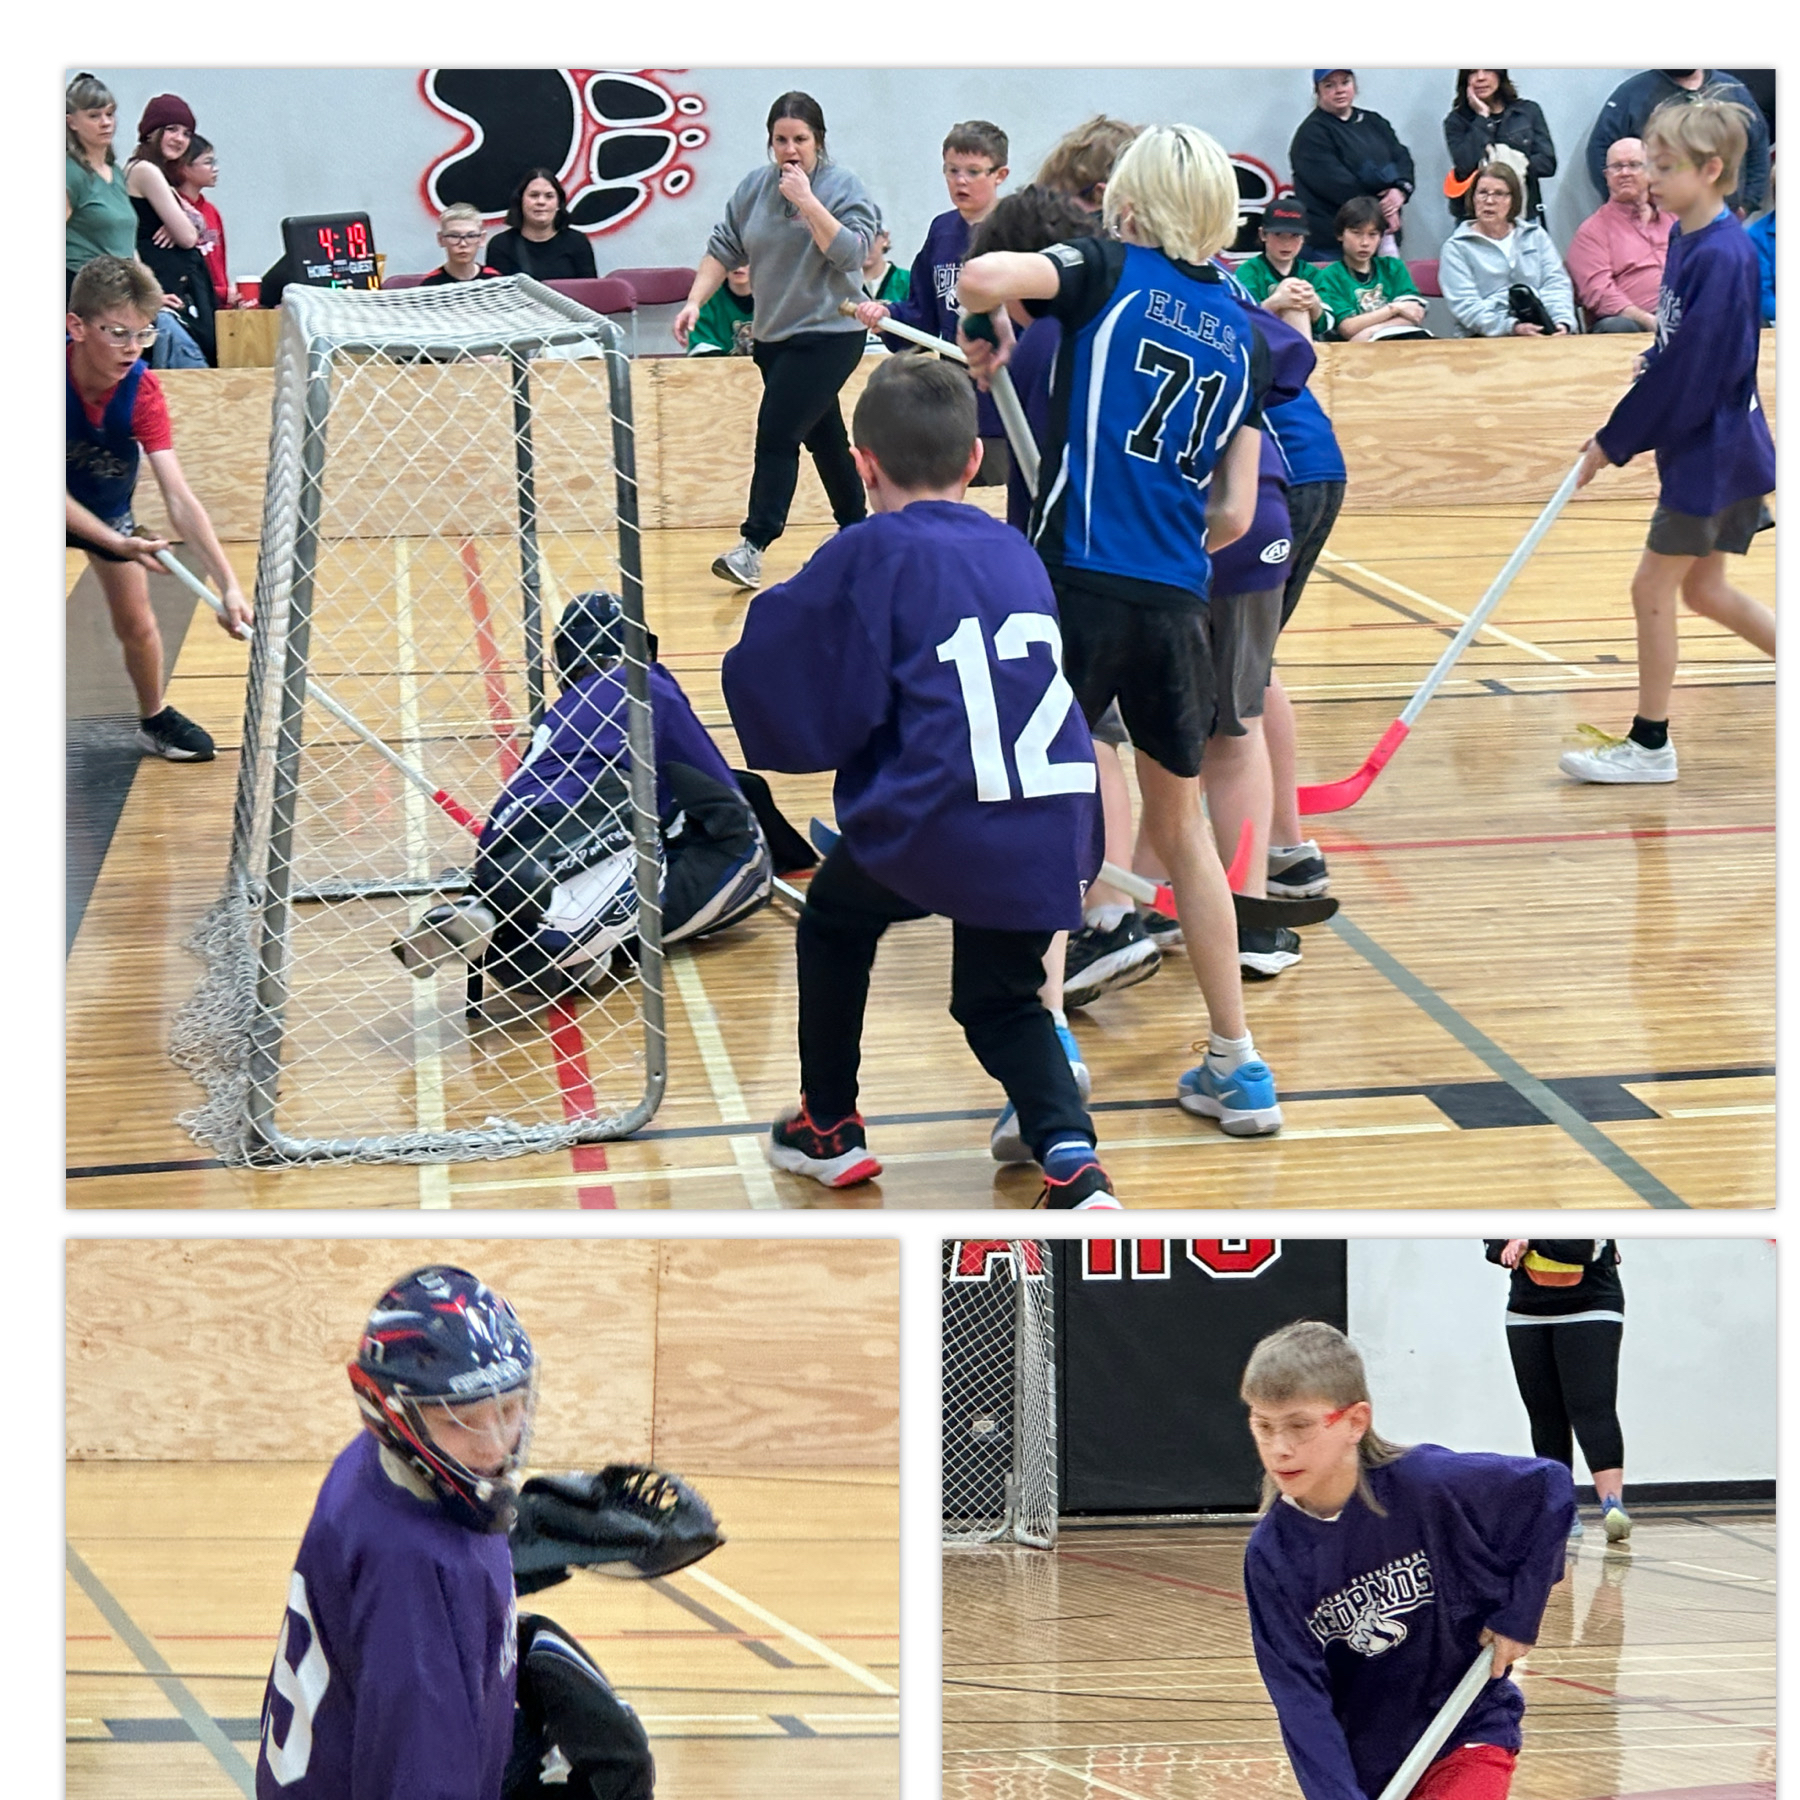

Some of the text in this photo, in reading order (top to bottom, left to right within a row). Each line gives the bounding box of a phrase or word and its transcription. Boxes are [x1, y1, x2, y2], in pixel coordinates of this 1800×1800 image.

[318, 222, 367, 260] 4:19
[1124, 338, 1227, 484] 71
[935, 612, 1097, 802] 12
